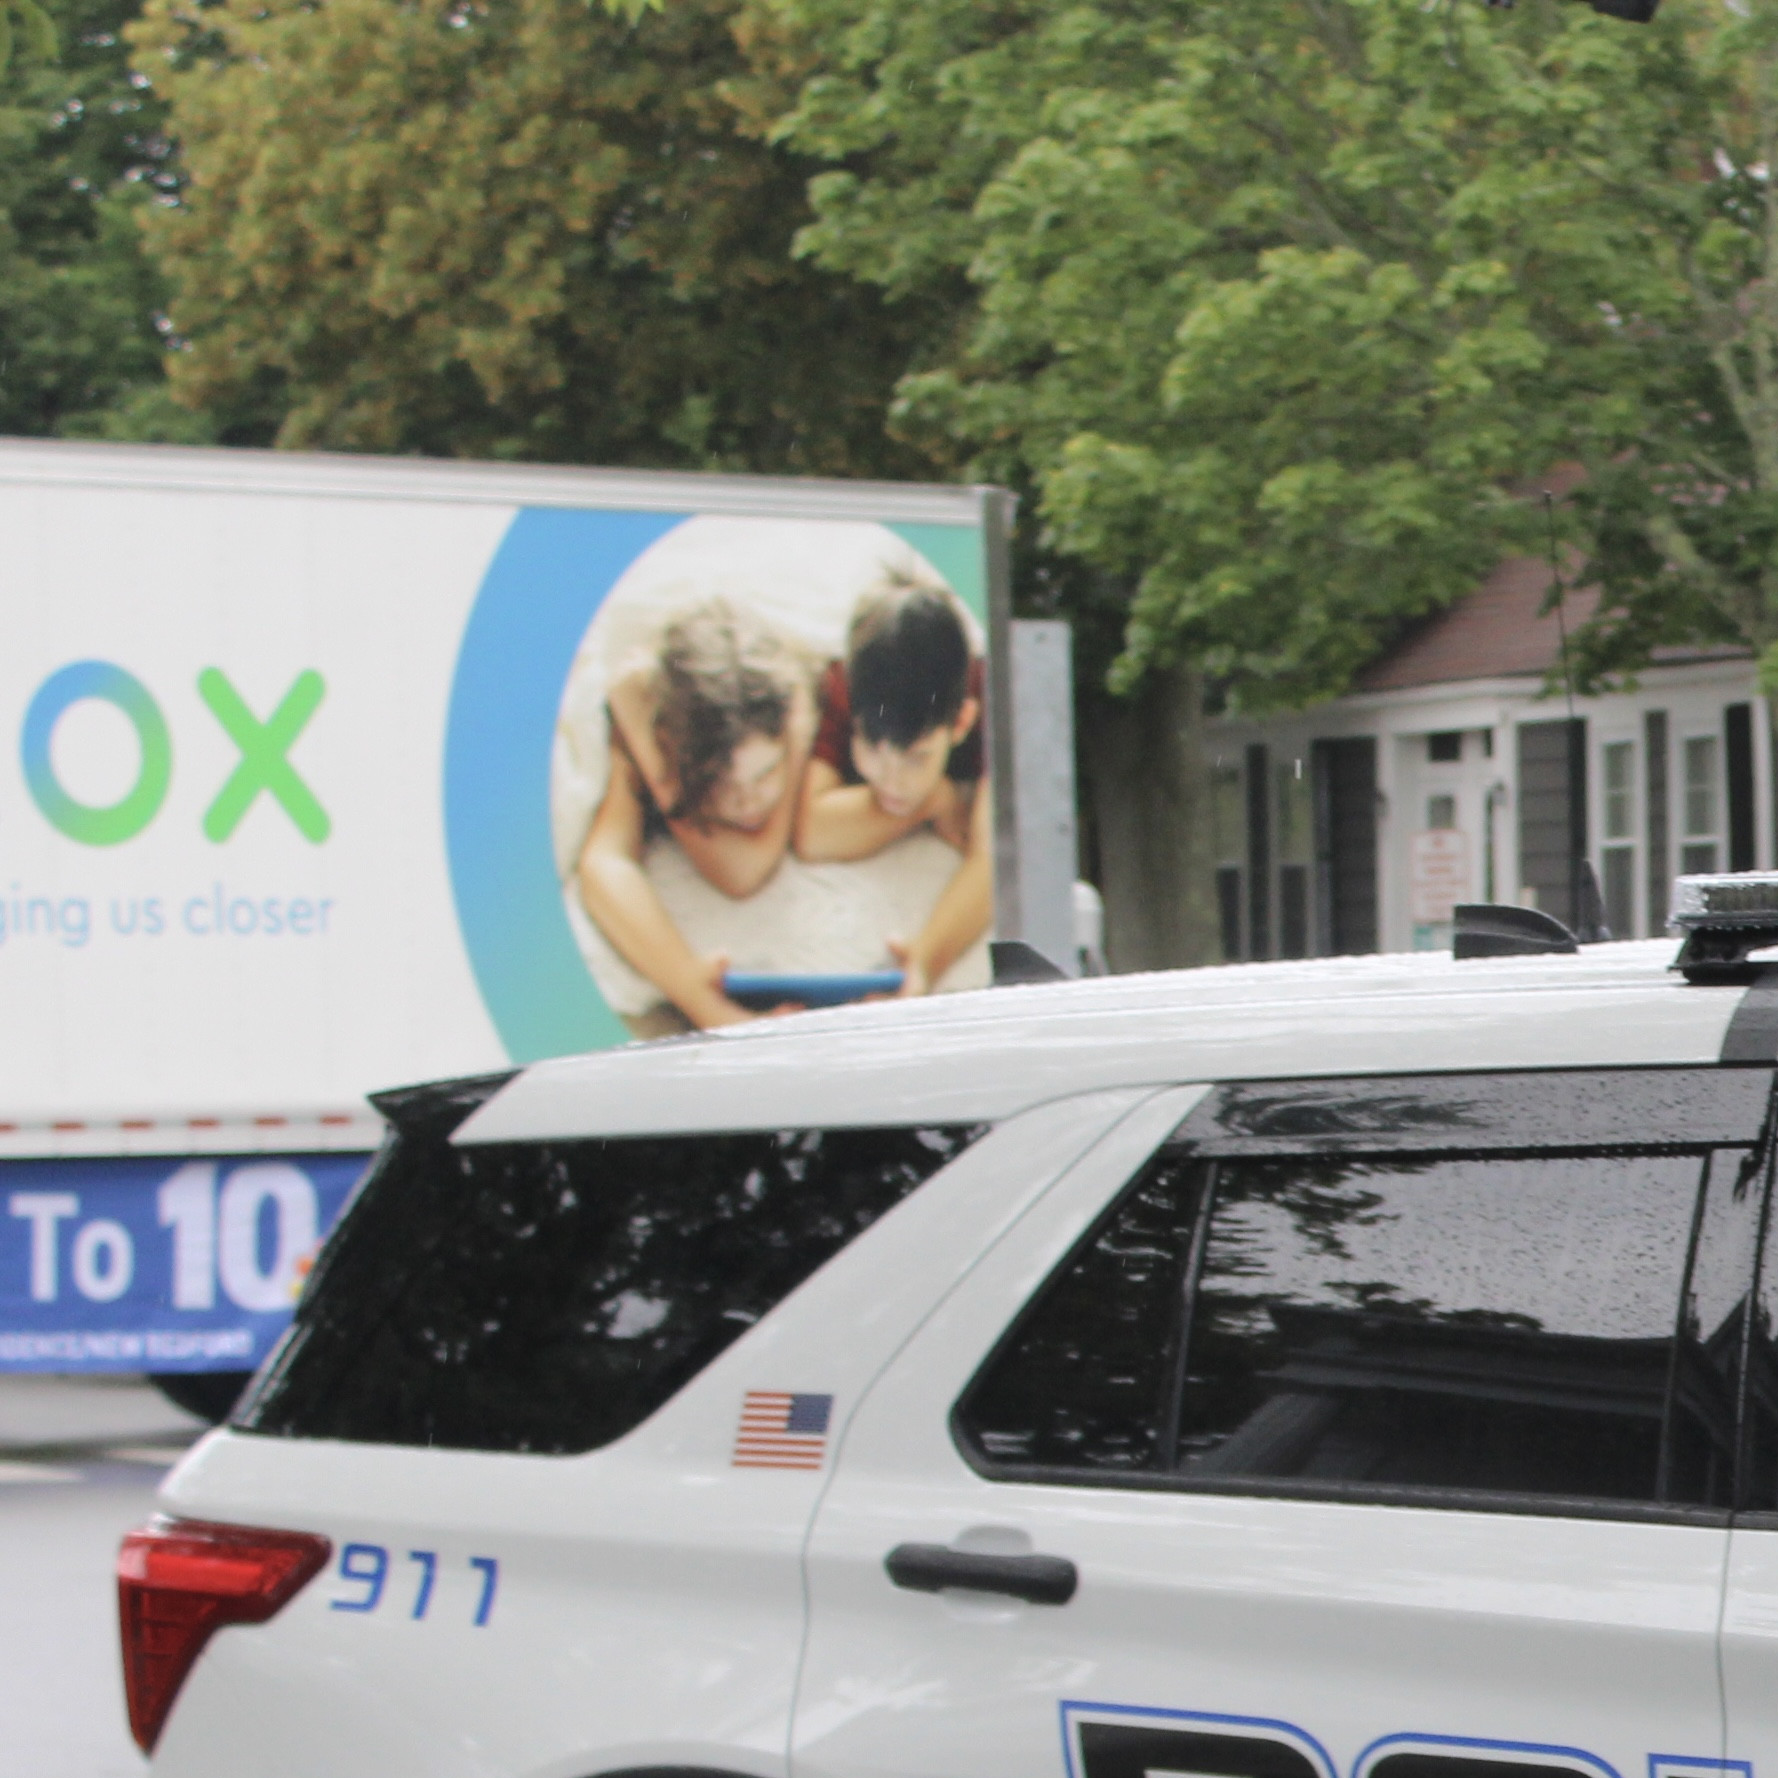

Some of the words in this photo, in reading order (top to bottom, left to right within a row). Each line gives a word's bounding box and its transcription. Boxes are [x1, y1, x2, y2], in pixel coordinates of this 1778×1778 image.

[109, 896, 165, 936] us
[181, 880, 337, 936] closer
[9, 1191, 135, 1303] To
[157, 1160, 320, 1313] 10
[329, 1542, 498, 1627] 911
